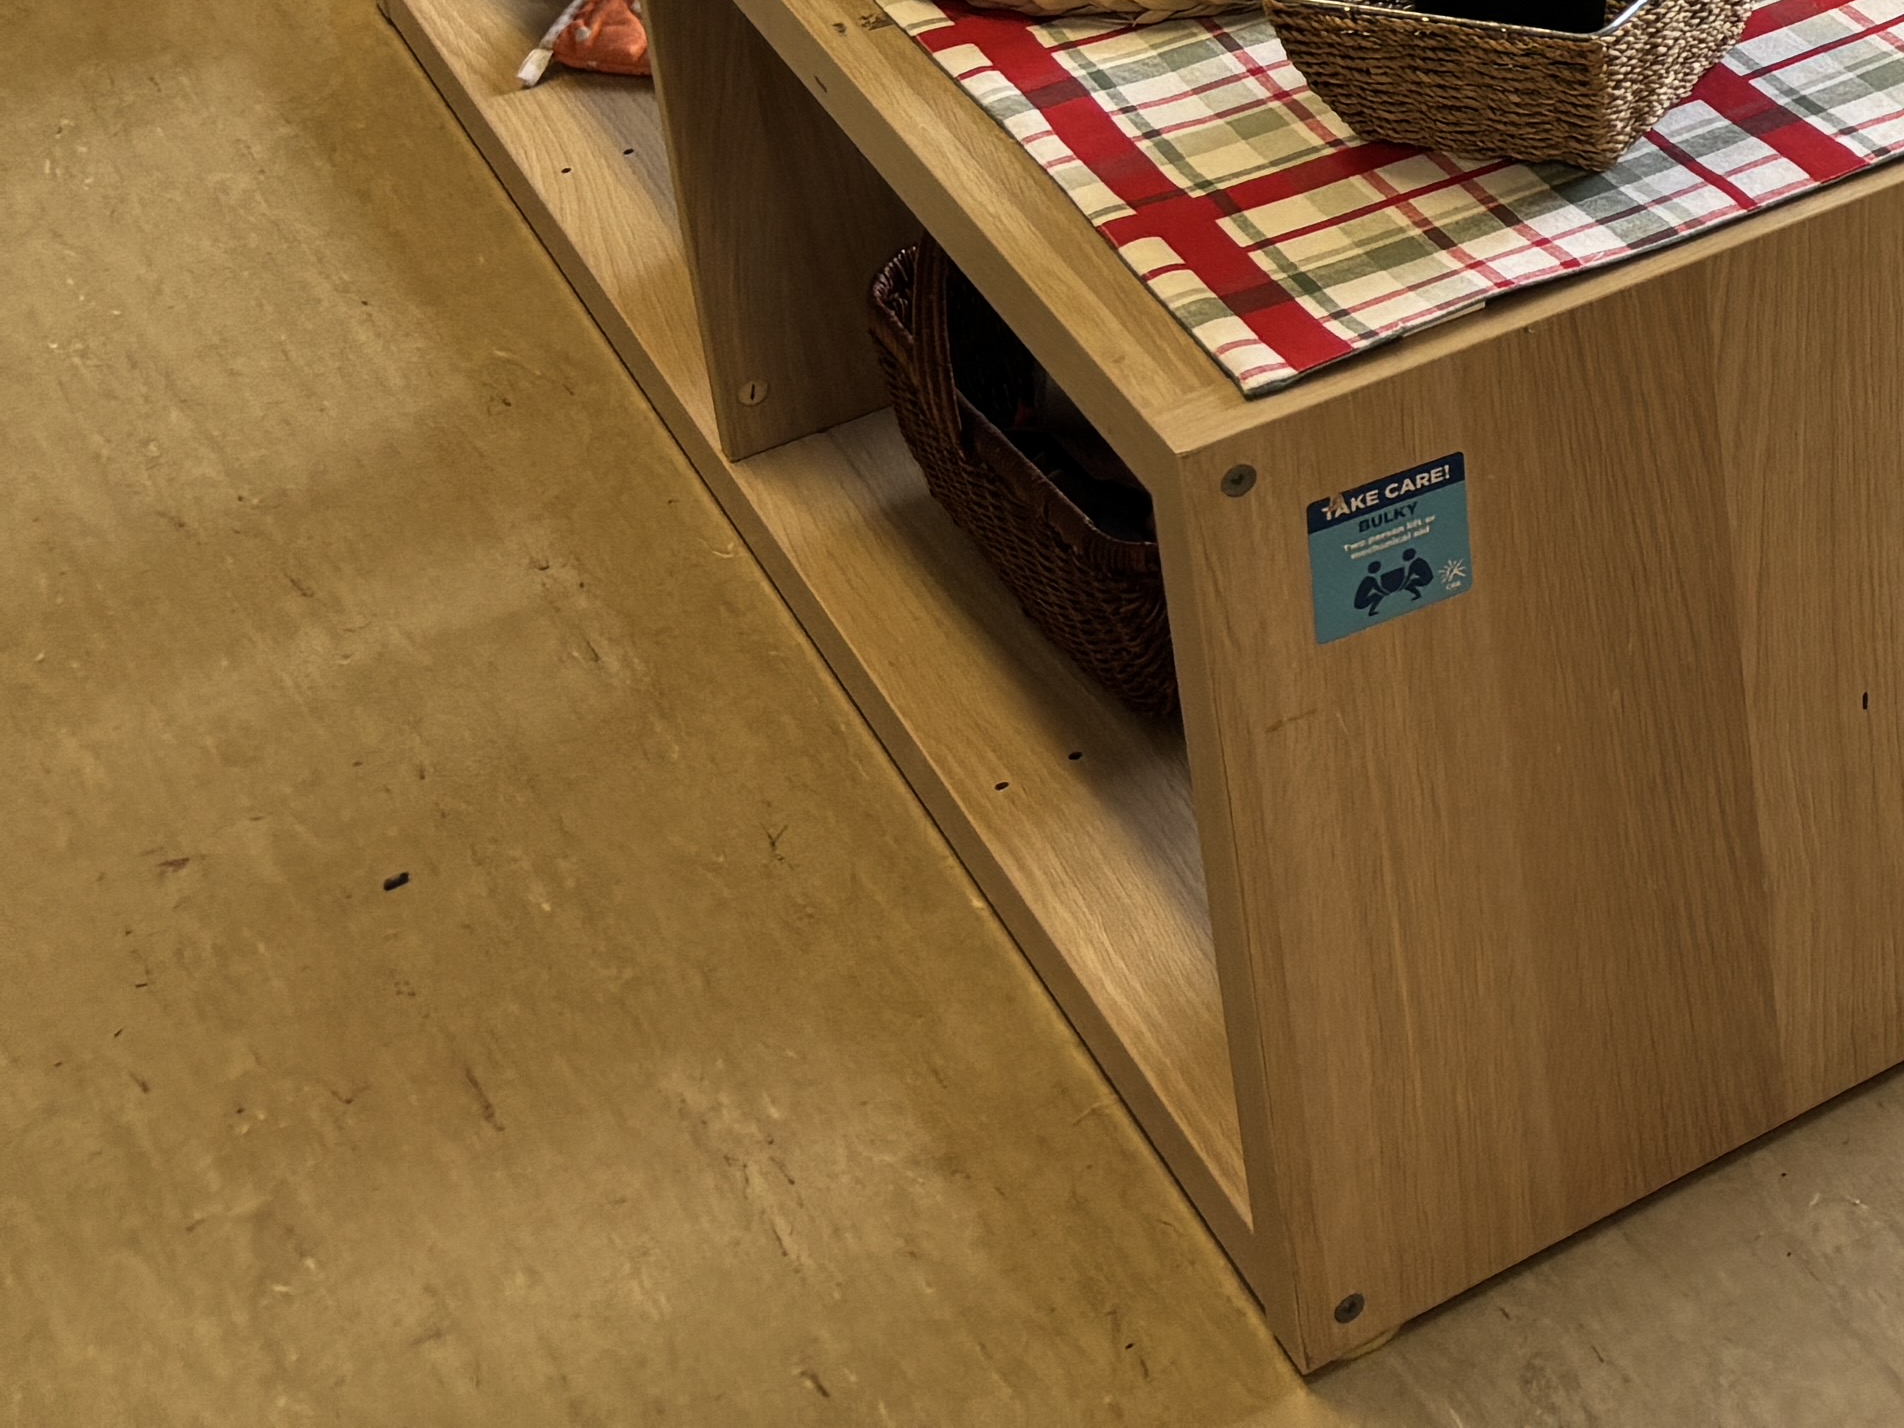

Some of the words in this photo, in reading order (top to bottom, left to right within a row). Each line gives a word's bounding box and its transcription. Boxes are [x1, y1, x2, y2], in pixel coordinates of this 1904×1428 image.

[1321, 489, 1380, 521] TAKE
[1385, 465, 1450, 498] CARE!
[1358, 501, 1418, 533] BULKY
[1368, 525, 1406, 545] person
[1406, 518, 1422, 530] lift
[1350, 531, 1411, 560] mechanical
[1412, 525, 1430, 538] aid
